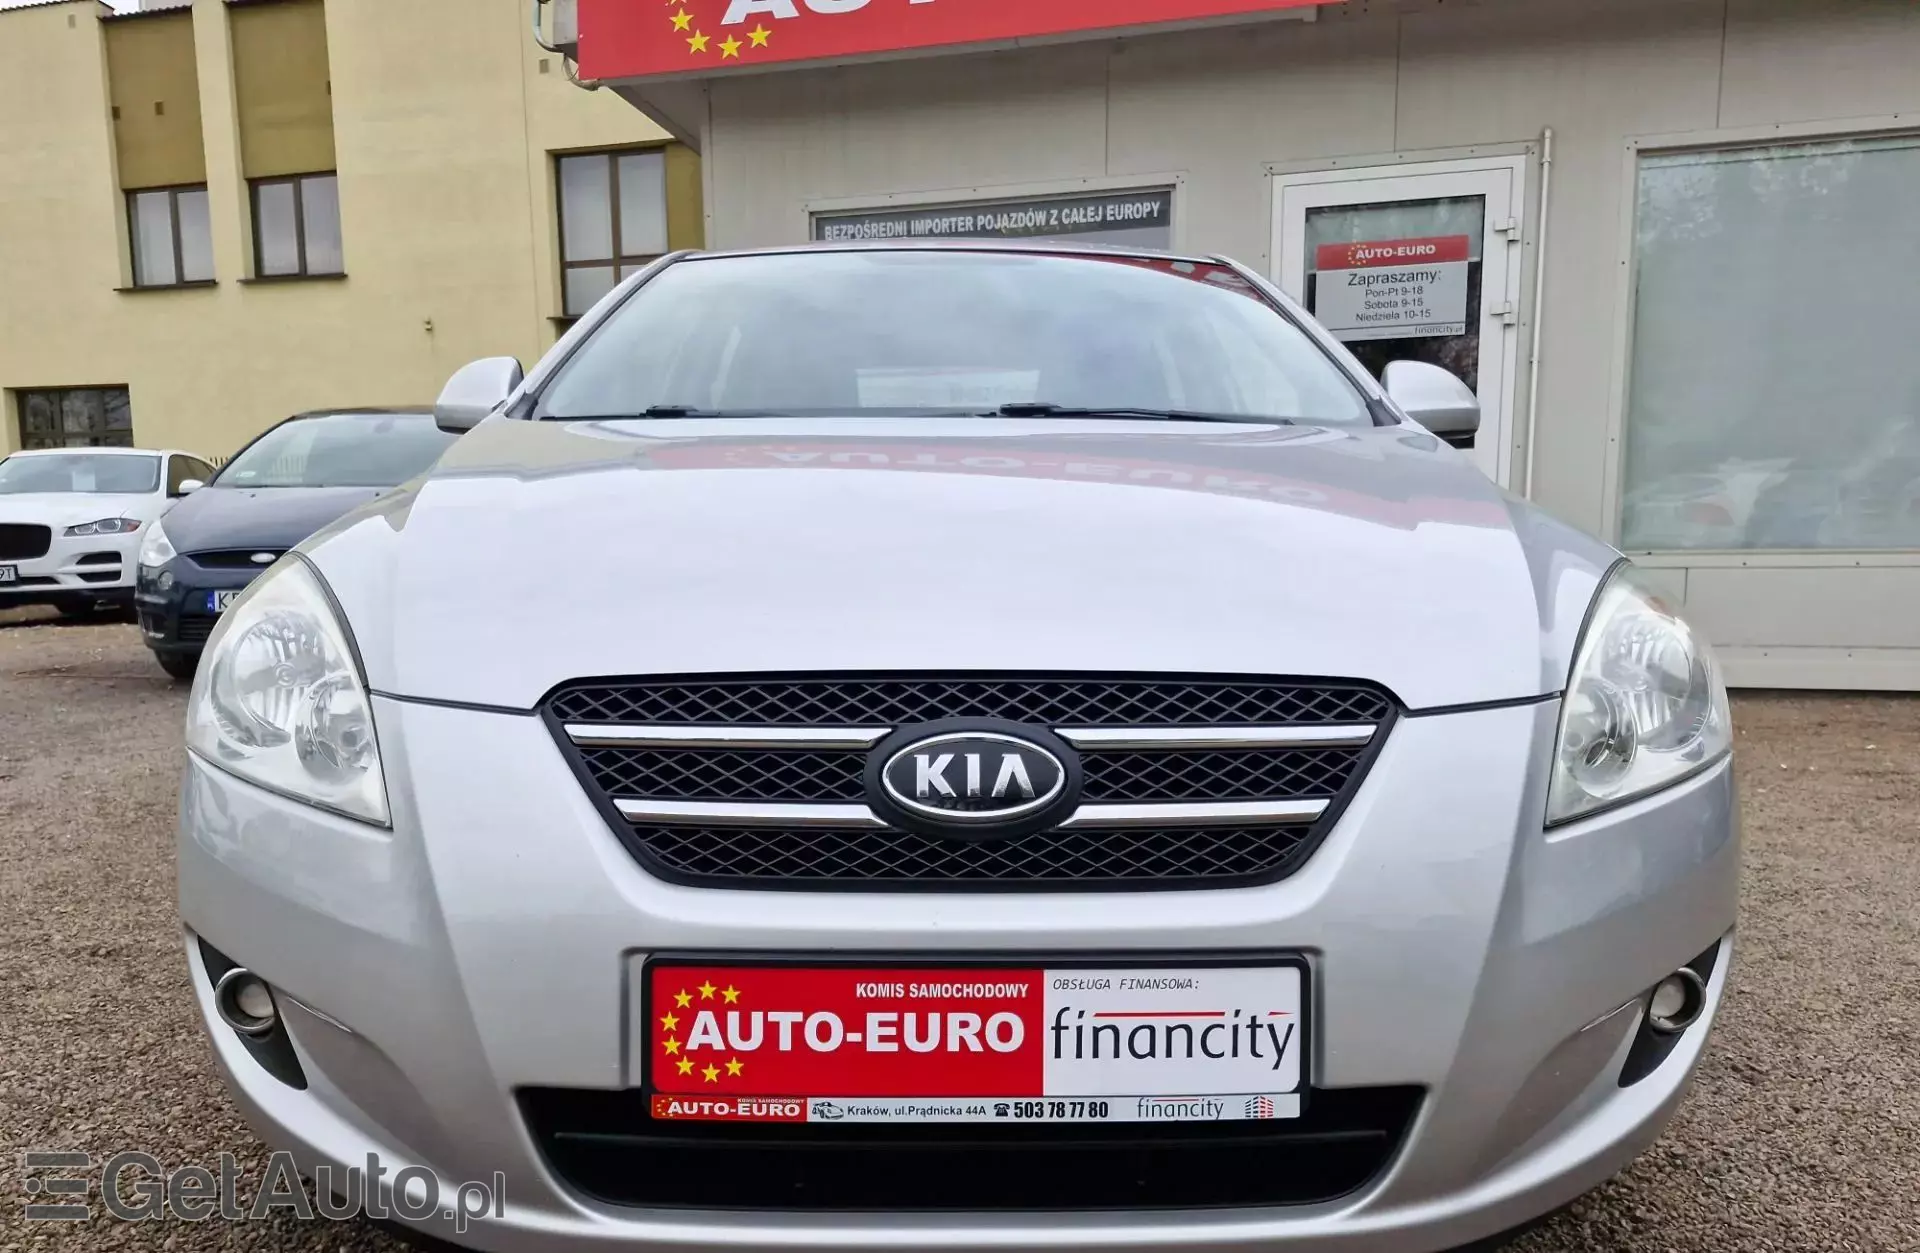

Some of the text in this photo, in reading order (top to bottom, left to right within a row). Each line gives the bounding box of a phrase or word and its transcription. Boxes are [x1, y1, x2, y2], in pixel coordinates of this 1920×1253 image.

[824, 201, 1161, 241] BEZPOŚREDNI IMPORTER POJAZDÓW Z CAŁEJ EUROPY
[1355, 244, 1436, 260] AUTO-EURO
[1348, 270, 1442, 287] Zapraszamy:
[1365, 286, 1424, 298] Pon-Pt 9-18
[1364, 298, 1424, 310] Sobota 9-15
[1355, 309, 1431, 322] Niedziela 10-15
[913, 752, 1036, 799] KIA
[856, 982, 1029, 999] KOMIS SAMOCHODOWY
[1052, 978, 1200, 991] OBSŁUGA FINANSOWA:
[685, 1010, 1025, 1053] AUTO-EURO
[1050, 1006, 1295, 1071] financity
[667, 1101, 801, 1116] AUTO-EURO
[847, 1104, 987, 1117] Kraków, ul.Prądnicka 44A
[1013, 1101, 1109, 1119] 503 78 77 80
[1136, 1097, 1225, 1120] financity
